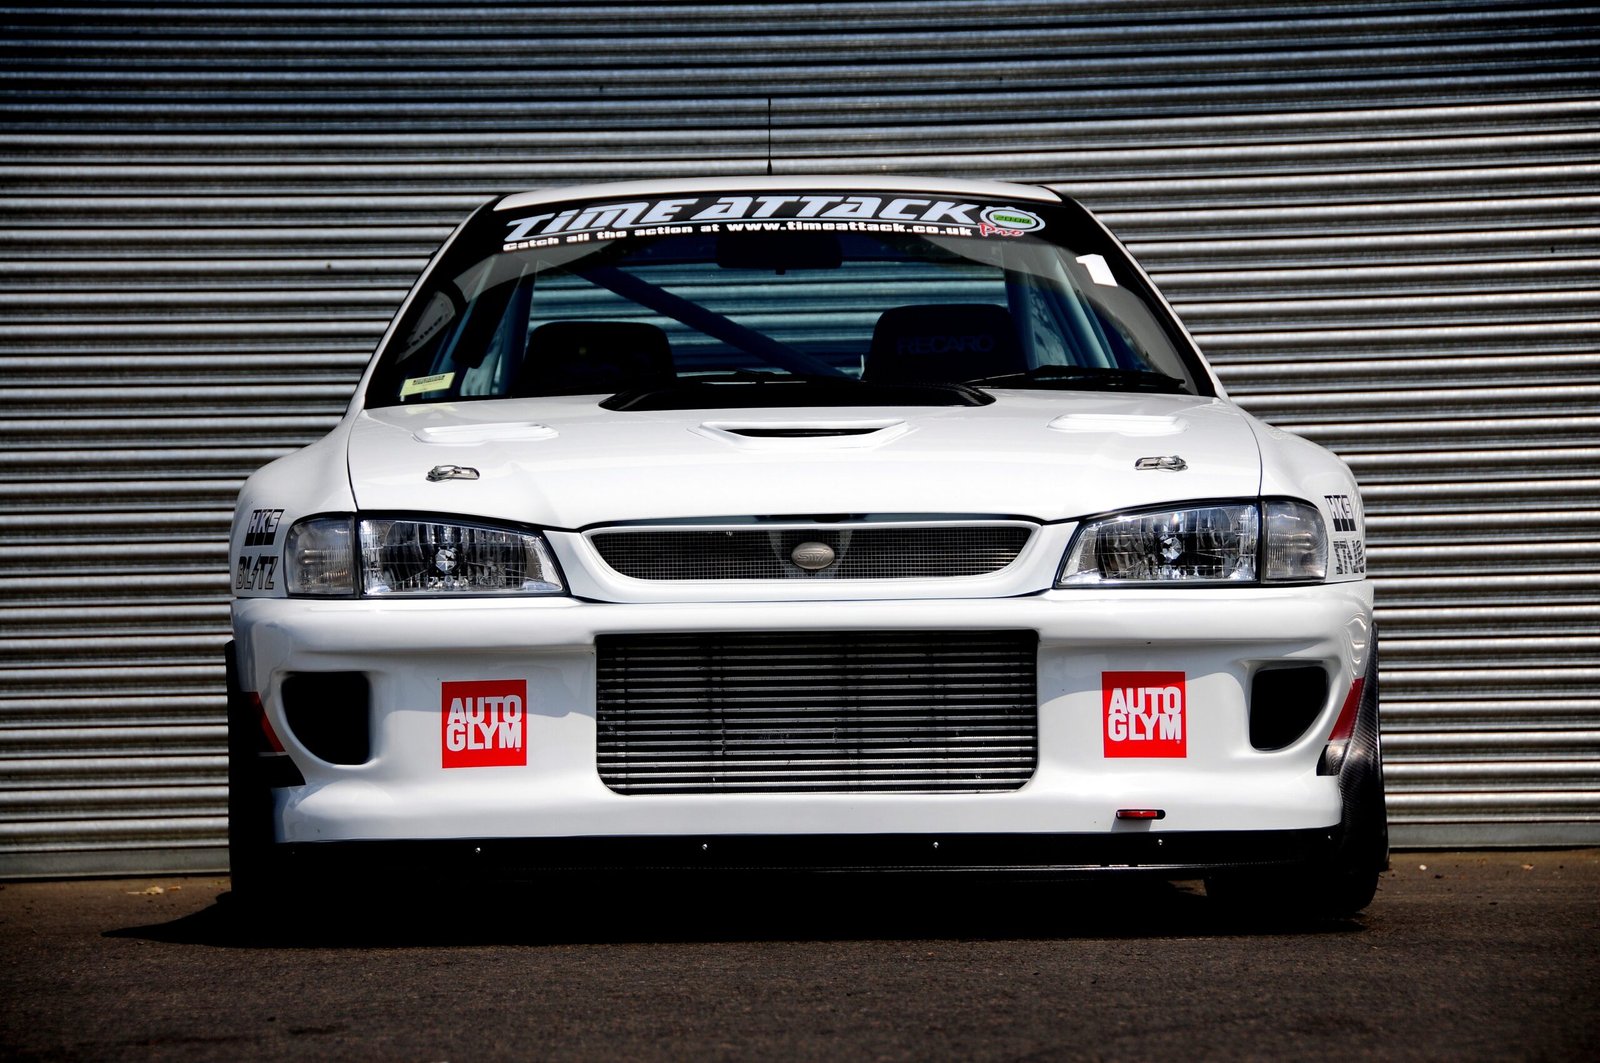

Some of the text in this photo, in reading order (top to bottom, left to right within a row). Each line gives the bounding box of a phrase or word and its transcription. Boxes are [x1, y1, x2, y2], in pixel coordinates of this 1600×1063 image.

[691, 196, 981, 224] ATTACK
[566, 232, 590, 243] all
[596, 229, 627, 240] the
[634, 225, 693, 236] action
[700, 223, 720, 233] at
[726, 221, 973, 237] www.timeattack.co.uk
[978, 222, 1025, 237] Pro
[895, 333, 996, 356] RECARO
[245, 509, 285, 539] HKS
[447, 694, 522, 725] AUTO
[1108, 686, 1182, 715] AUTO
[446, 722, 522, 752] GLYM
[1107, 712, 1182, 742] GLYM
